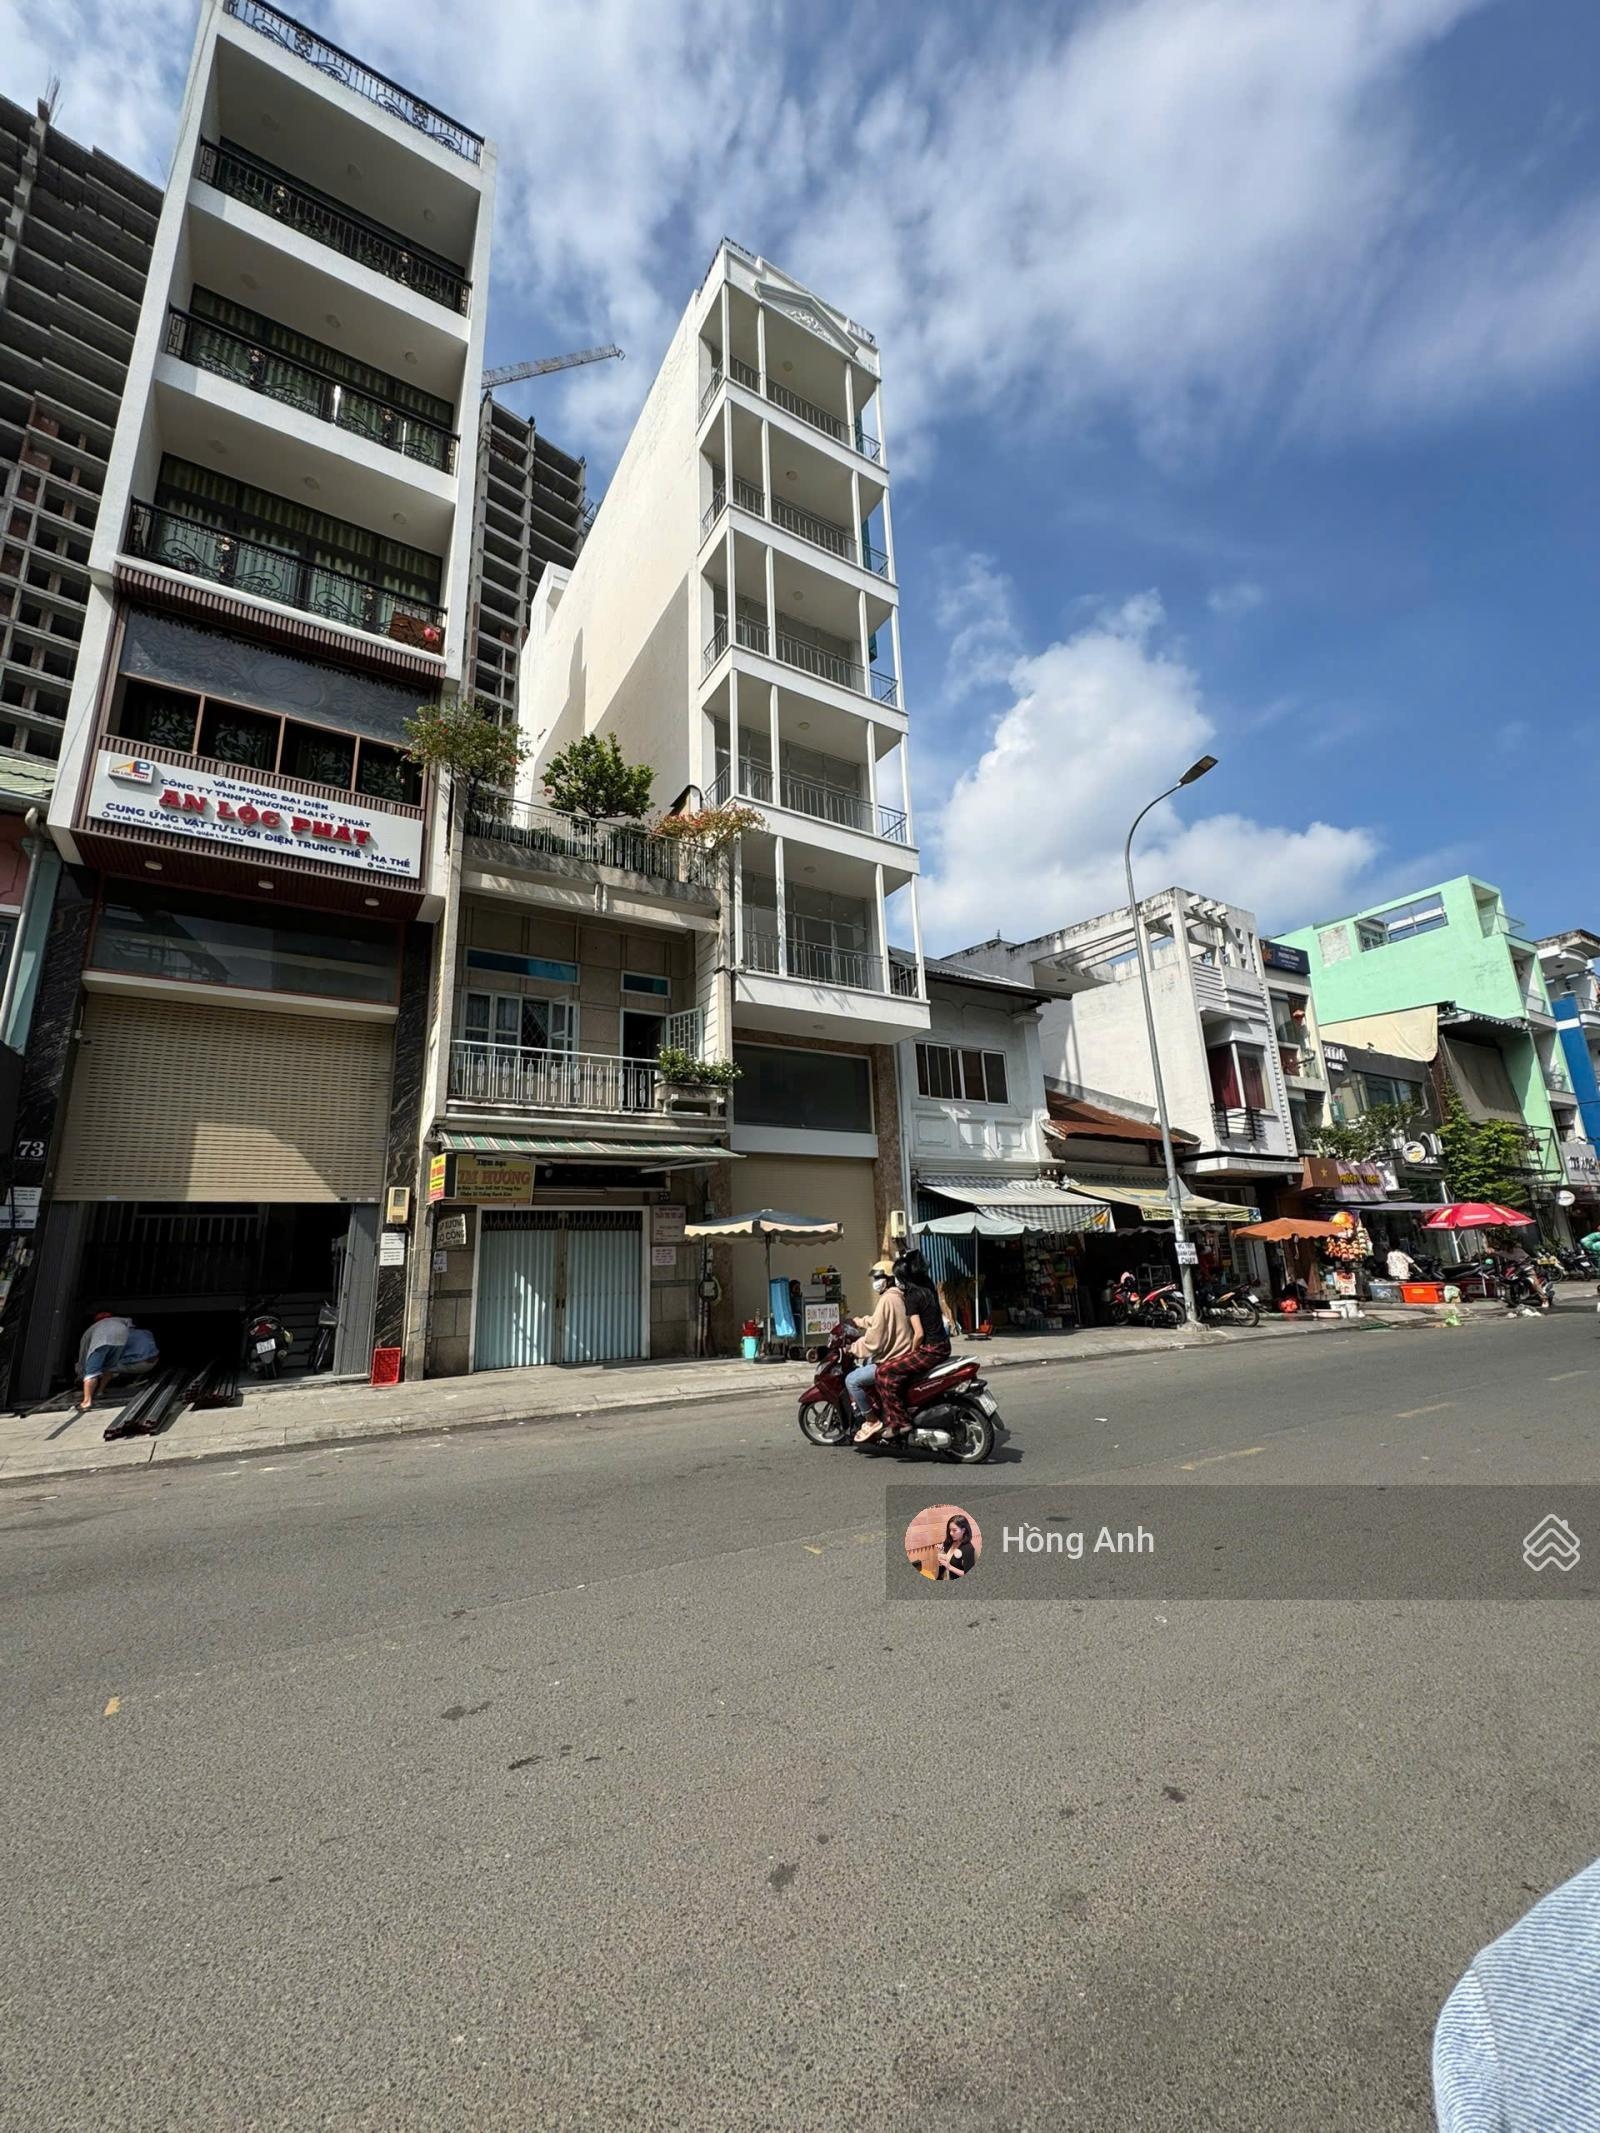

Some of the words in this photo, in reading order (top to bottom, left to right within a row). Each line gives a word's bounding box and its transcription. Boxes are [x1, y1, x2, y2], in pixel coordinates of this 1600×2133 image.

[159, 788, 208, 814] AN
[217, 800, 282, 829] LỘC
[290, 815, 371, 847] PHÁT
[160, 778, 194, 791] CÔNG
[197, 786, 213, 795] TY
[215, 790, 247, 803] TNHH
[249, 796, 295, 813] THƯƠNG
[297, 807, 318, 819] MẠI
[338, 815, 371, 828] THUẬT
[239, 785, 278, 800] PHÒNG
[303, 799, 329, 811] DIỆN
[105, 801, 146, 818] CUNG
[149, 809, 180, 824] ỨNG
[182, 816, 208, 829] VẬT
[210, 821, 231, 833] TƯ
[231, 826, 261, 841] LƯỚI
[264, 832, 294, 846] ĐIỆN
[296, 838, 337, 855] TRUNG
[339, 845, 362, 860] THẾ
[371, 853, 388, 865] HẠ
[390, 857, 411, 869] THẾ
[18, 1141, 45, 1157] 73
